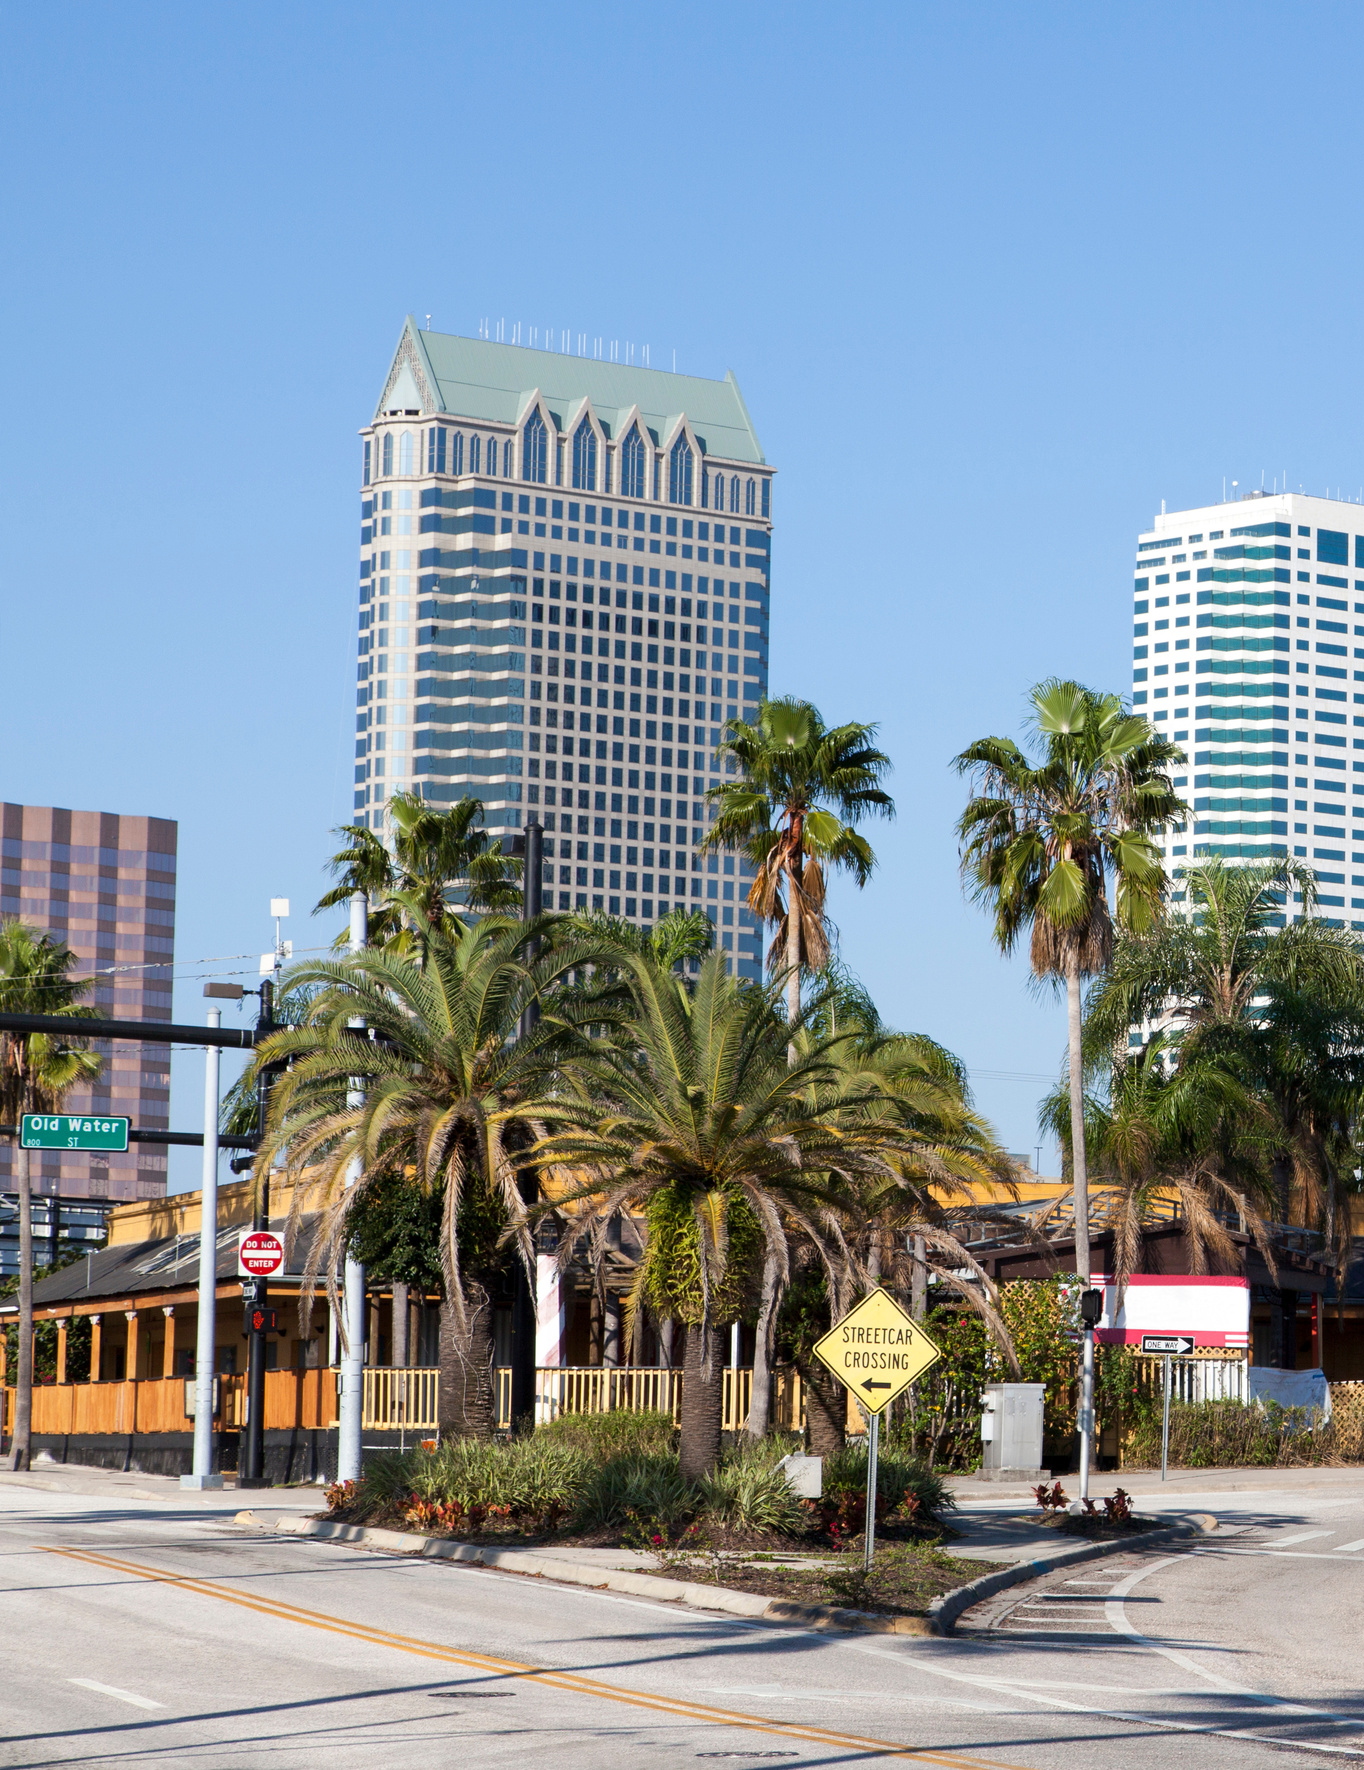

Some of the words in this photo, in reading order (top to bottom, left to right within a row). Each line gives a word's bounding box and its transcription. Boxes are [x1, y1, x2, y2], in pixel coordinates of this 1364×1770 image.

[31, 1117, 59, 1131] Old
[68, 1119, 119, 1133] Water
[67, 1137, 79, 1147] ST
[261, 1241, 278, 1249] NOT
[248, 1260, 274, 1268] ENTER
[842, 1326, 913, 1346] STREETCAR
[844, 1351, 909, 1370] CROSSING
